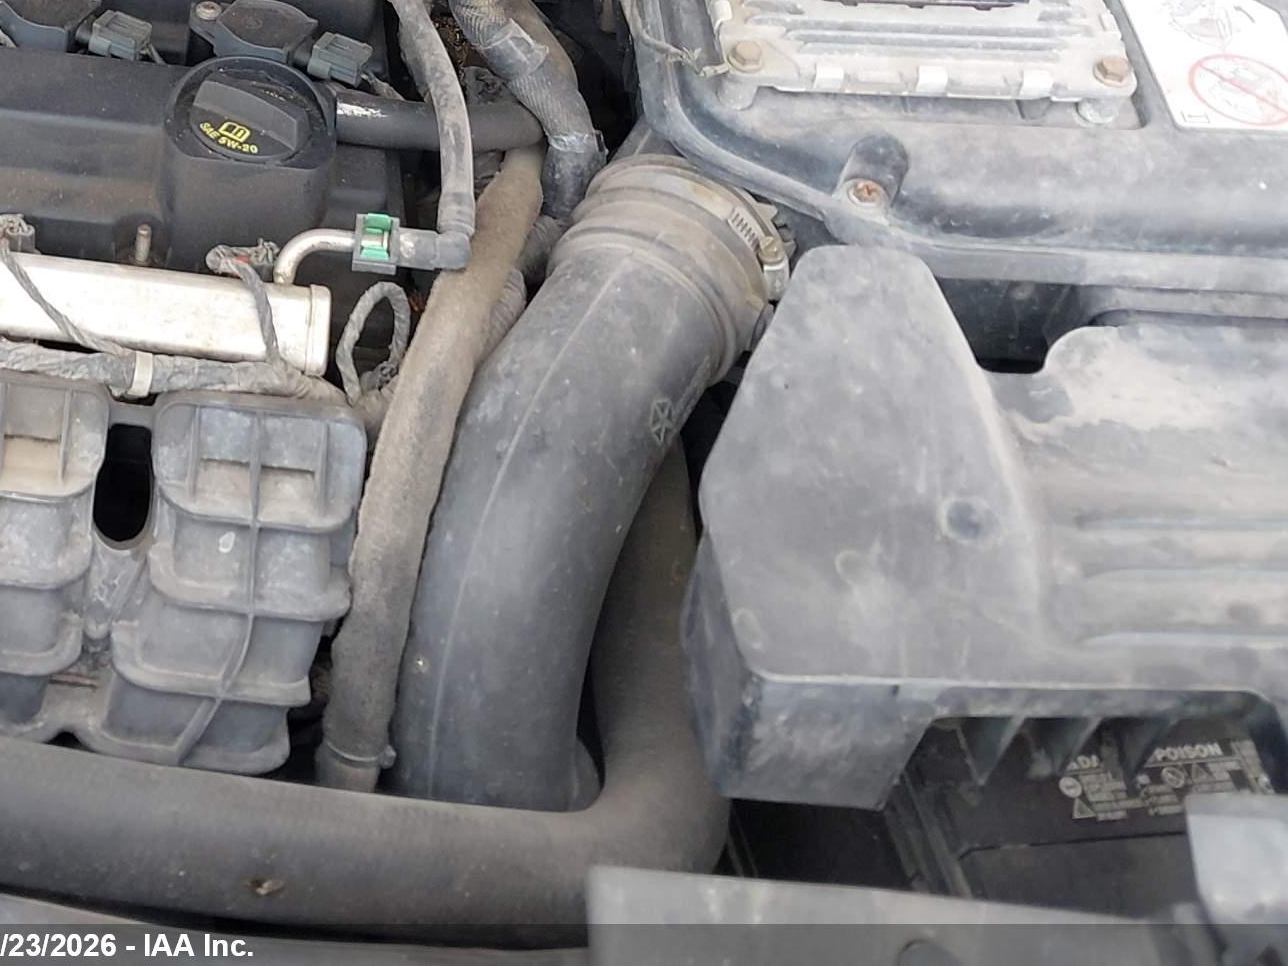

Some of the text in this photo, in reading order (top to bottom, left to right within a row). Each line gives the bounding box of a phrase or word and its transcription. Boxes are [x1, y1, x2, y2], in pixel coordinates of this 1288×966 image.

[199, 122, 258, 154] SAE 5W-20
[1154, 742, 1224, 762] POISON
